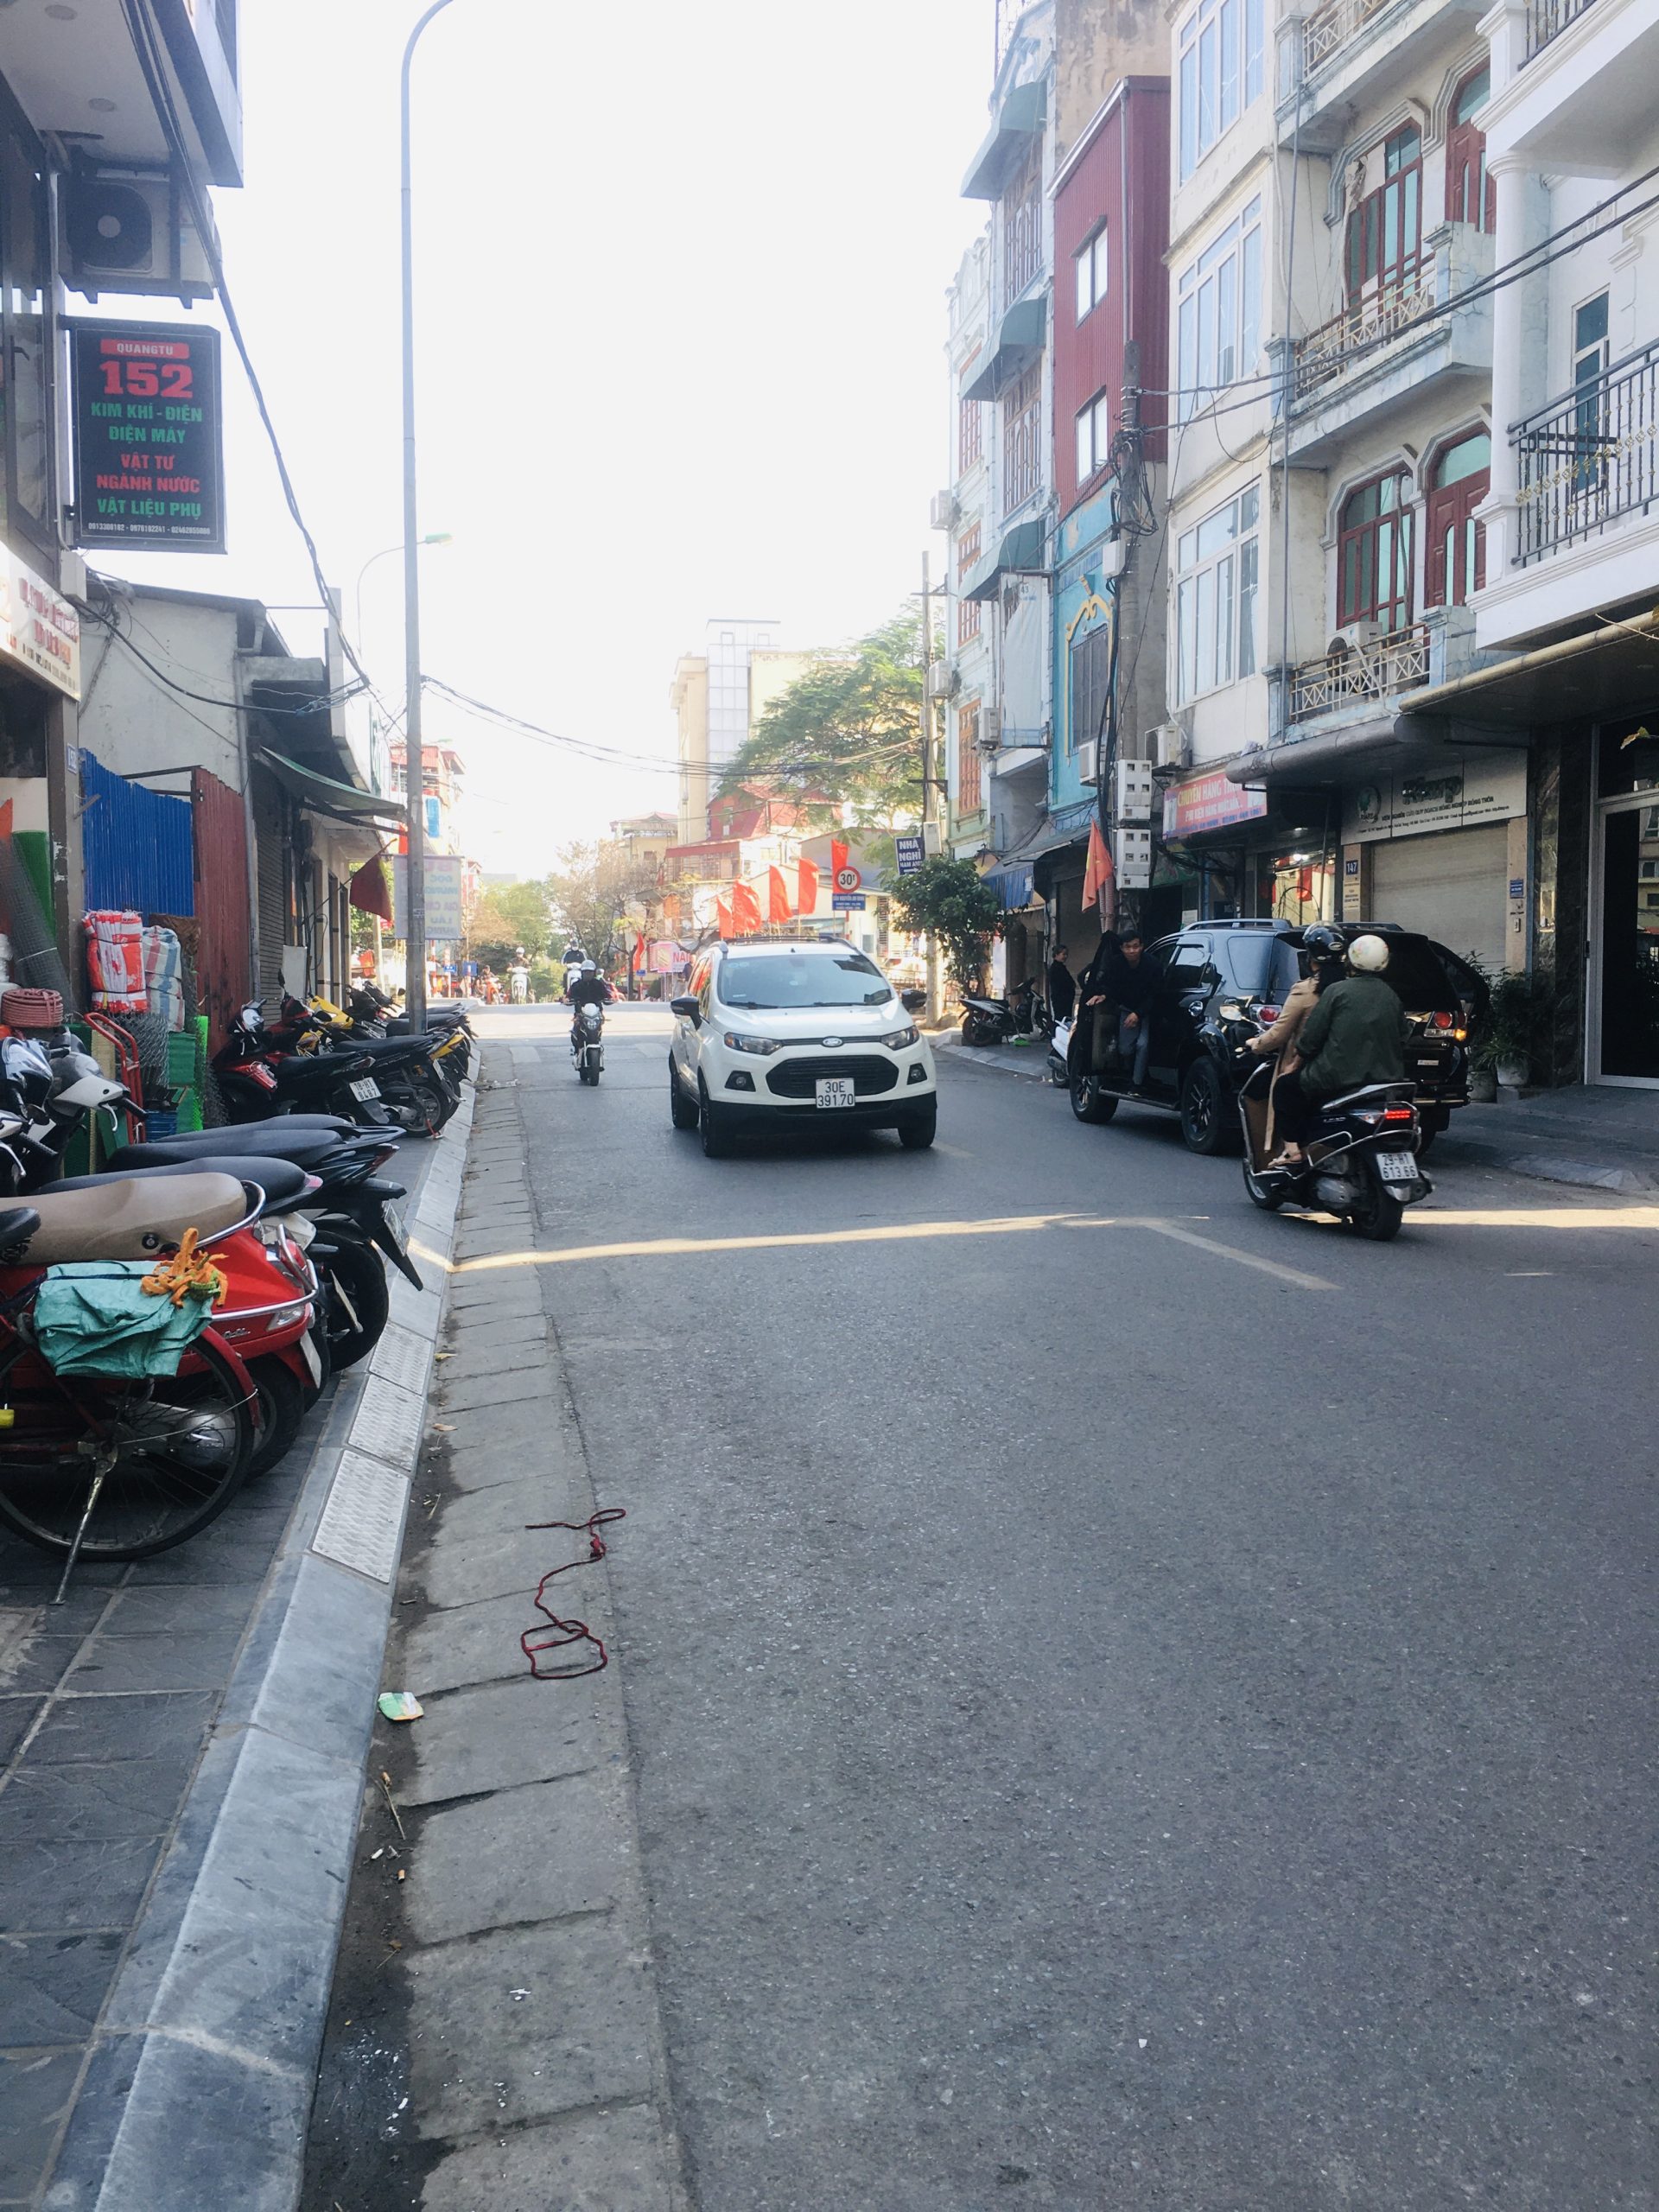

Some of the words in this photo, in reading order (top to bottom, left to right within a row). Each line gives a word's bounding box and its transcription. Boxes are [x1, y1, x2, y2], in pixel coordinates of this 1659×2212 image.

[99, 360, 194, 398] 152
[91, 402, 123, 417] KIM
[127, 403, 153, 420] KHÍ
[165, 404, 202, 424] ĐIỆN
[109, 424, 147, 444] ĐIỆN
[151, 426, 186, 444] MÁY
[121, 452, 150, 471] VẬT
[155, 454, 175, 470] TƯ
[96, 473, 153, 492] NGÀNH
[156, 475, 200, 493] NƯỚC
[97, 496, 127, 517] VẬT
[130, 498, 165, 518] LIỆU
[169, 501, 202, 520] PHỤ
[899, 838, 919, 850] NHÀ
[899, 849, 922, 861] NGHỈ
[825, 1081, 846, 1093] 30E
[817, 1093, 854, 1107] 391.70
